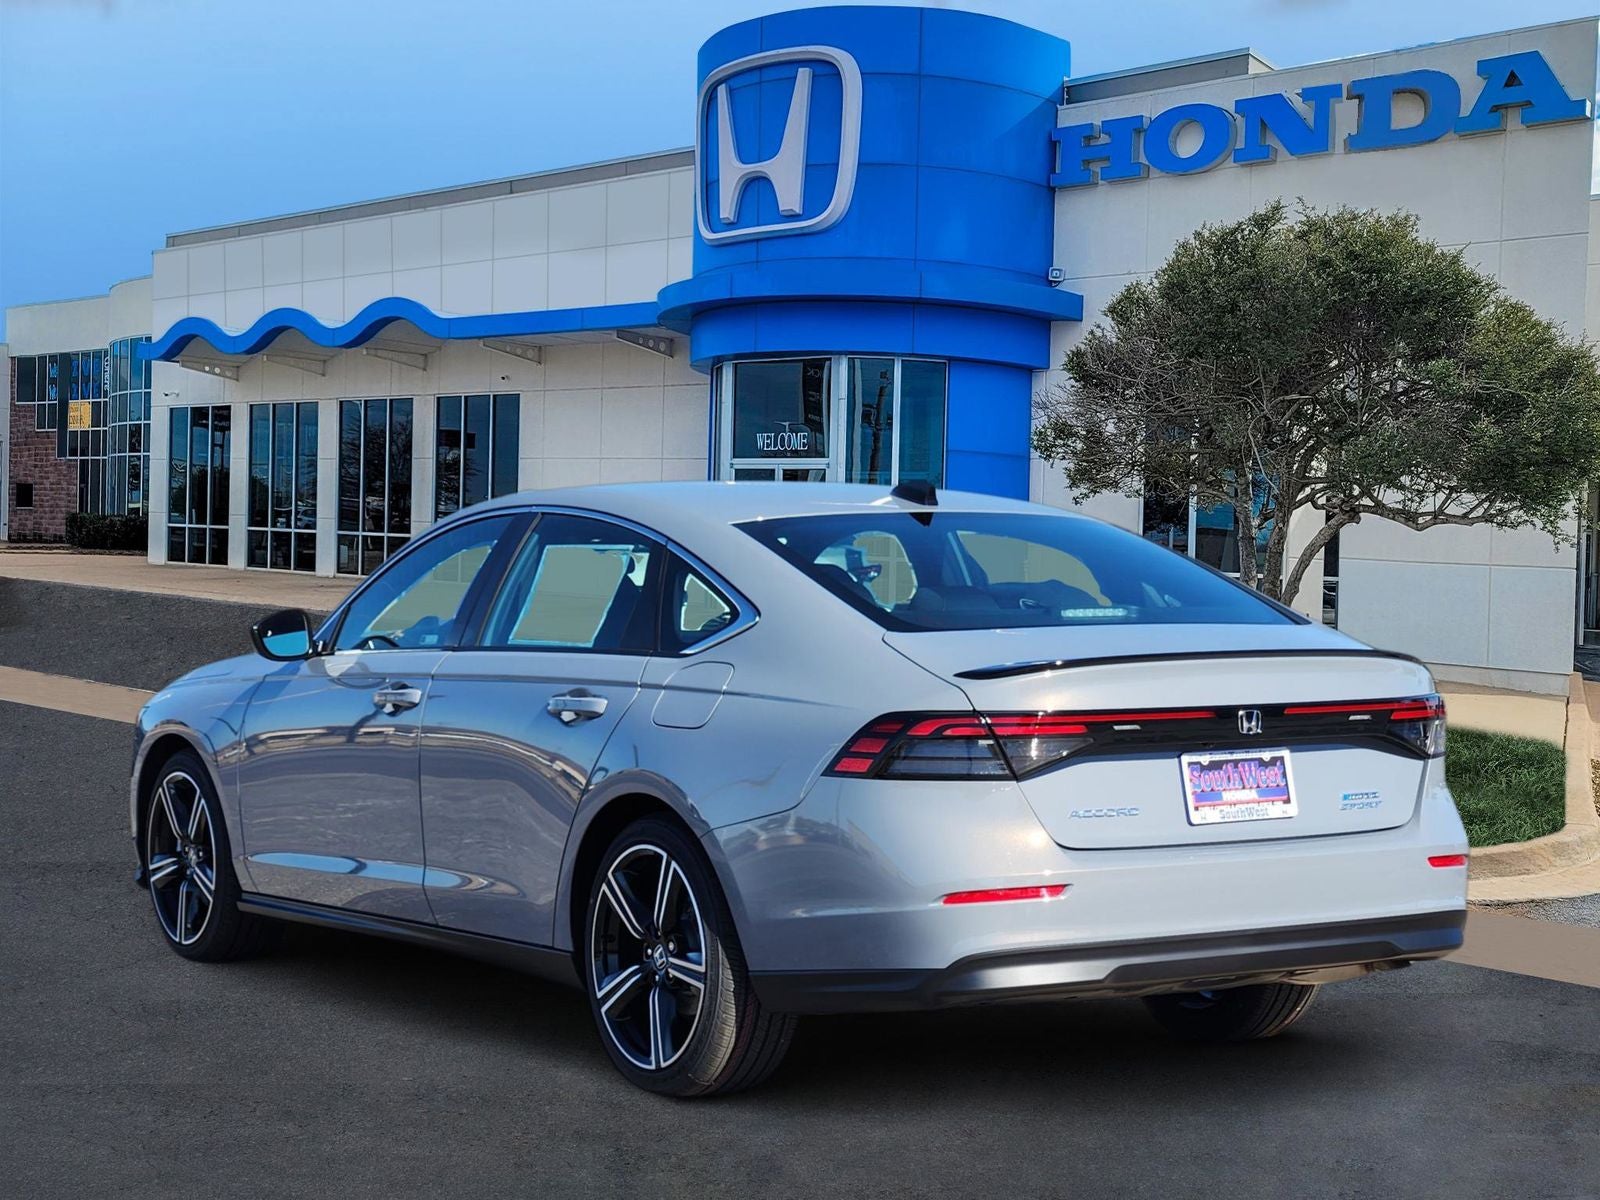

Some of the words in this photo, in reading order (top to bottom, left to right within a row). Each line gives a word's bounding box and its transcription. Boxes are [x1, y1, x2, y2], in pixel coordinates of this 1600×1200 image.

[1050, 50, 1592, 189] HONDA
[756, 432, 808, 451] WELCOME
[1068, 807, 1139, 820] ACCORD
